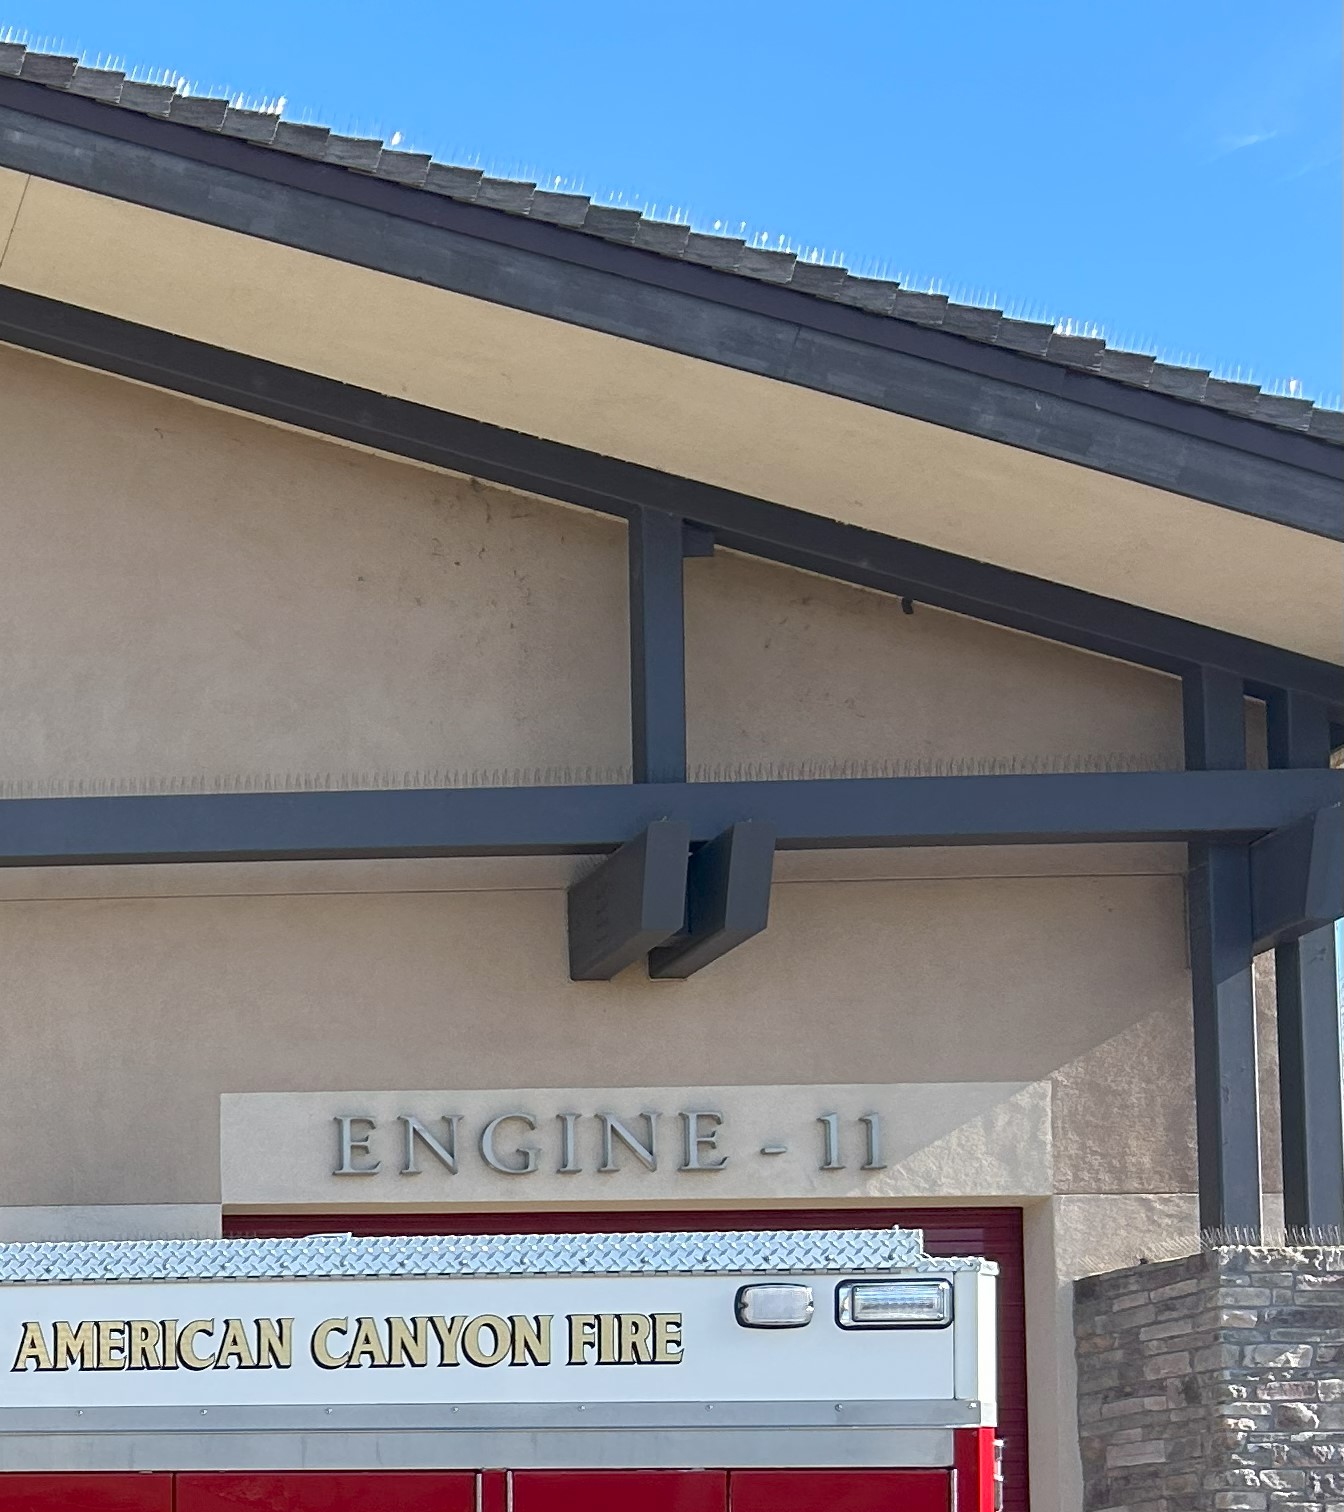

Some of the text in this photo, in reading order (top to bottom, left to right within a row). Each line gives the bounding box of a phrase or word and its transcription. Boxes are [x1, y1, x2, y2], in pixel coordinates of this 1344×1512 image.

[332, 1110, 729, 1178] ENGINE
[818, 1111, 888, 1171] 11
[10, 1311, 685, 1372] AMERICAN CANYON FIRE
